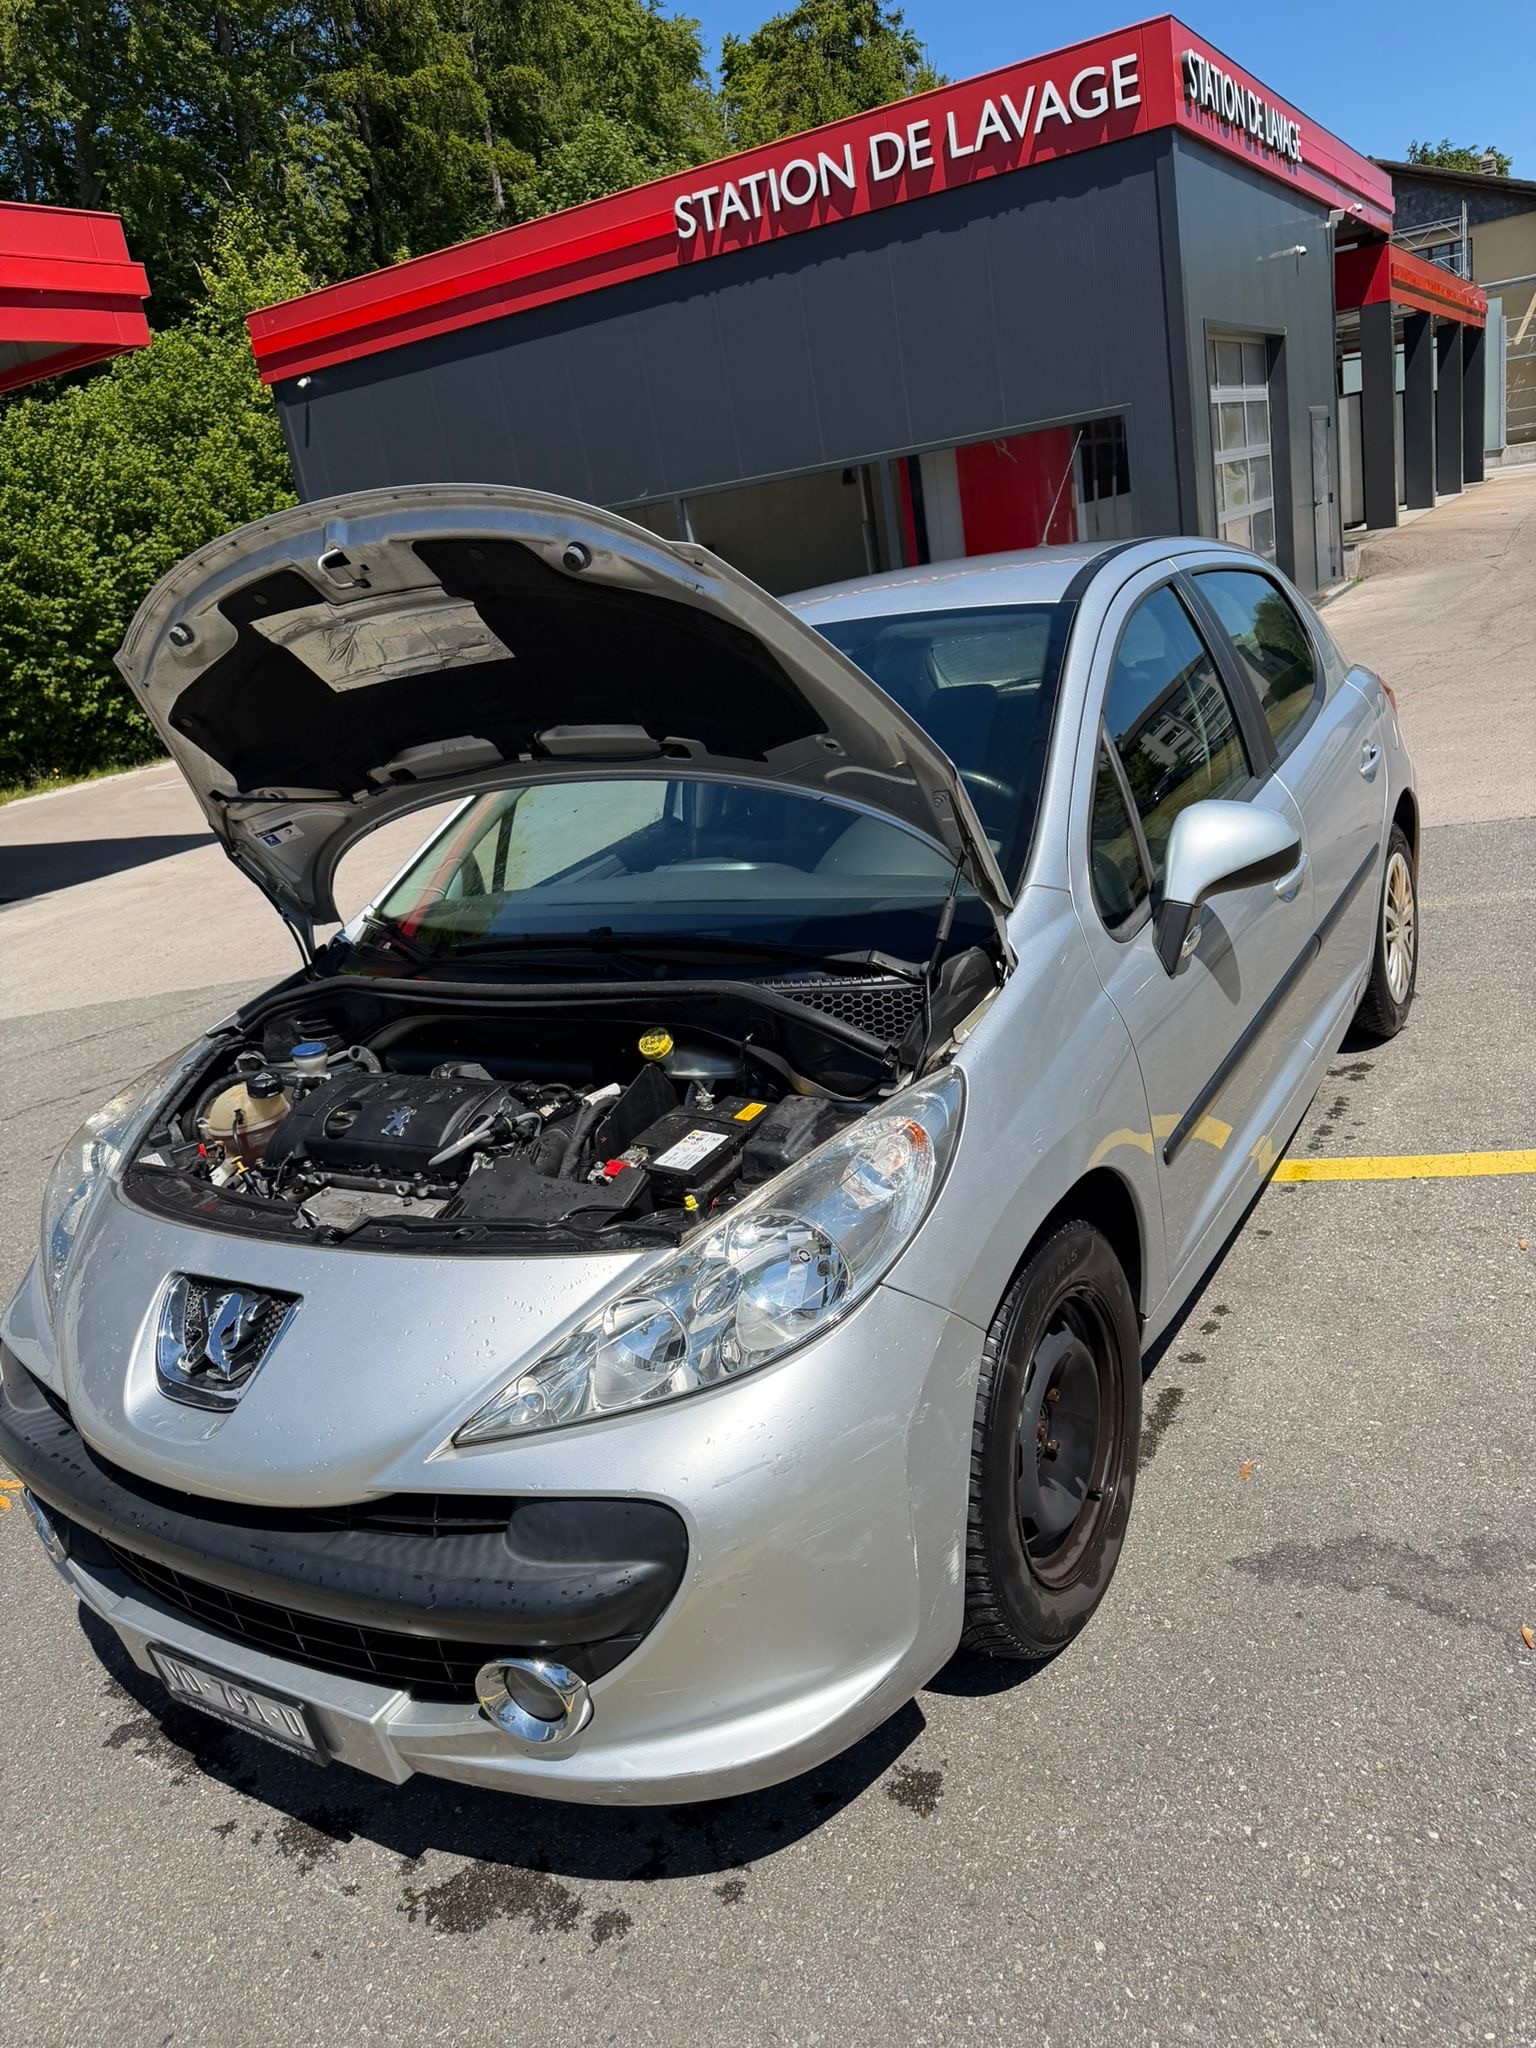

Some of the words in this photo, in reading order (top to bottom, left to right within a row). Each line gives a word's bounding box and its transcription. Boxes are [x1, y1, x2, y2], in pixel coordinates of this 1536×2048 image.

[674, 143, 857, 240] STATION
[868, 118, 935, 182] DE
[946, 53, 1142, 159] LAVAGE
[1184, 48, 1246, 129] STATION
[1247, 88, 1265, 140] DE
[1264, 102, 1303, 162] LAVAGE
